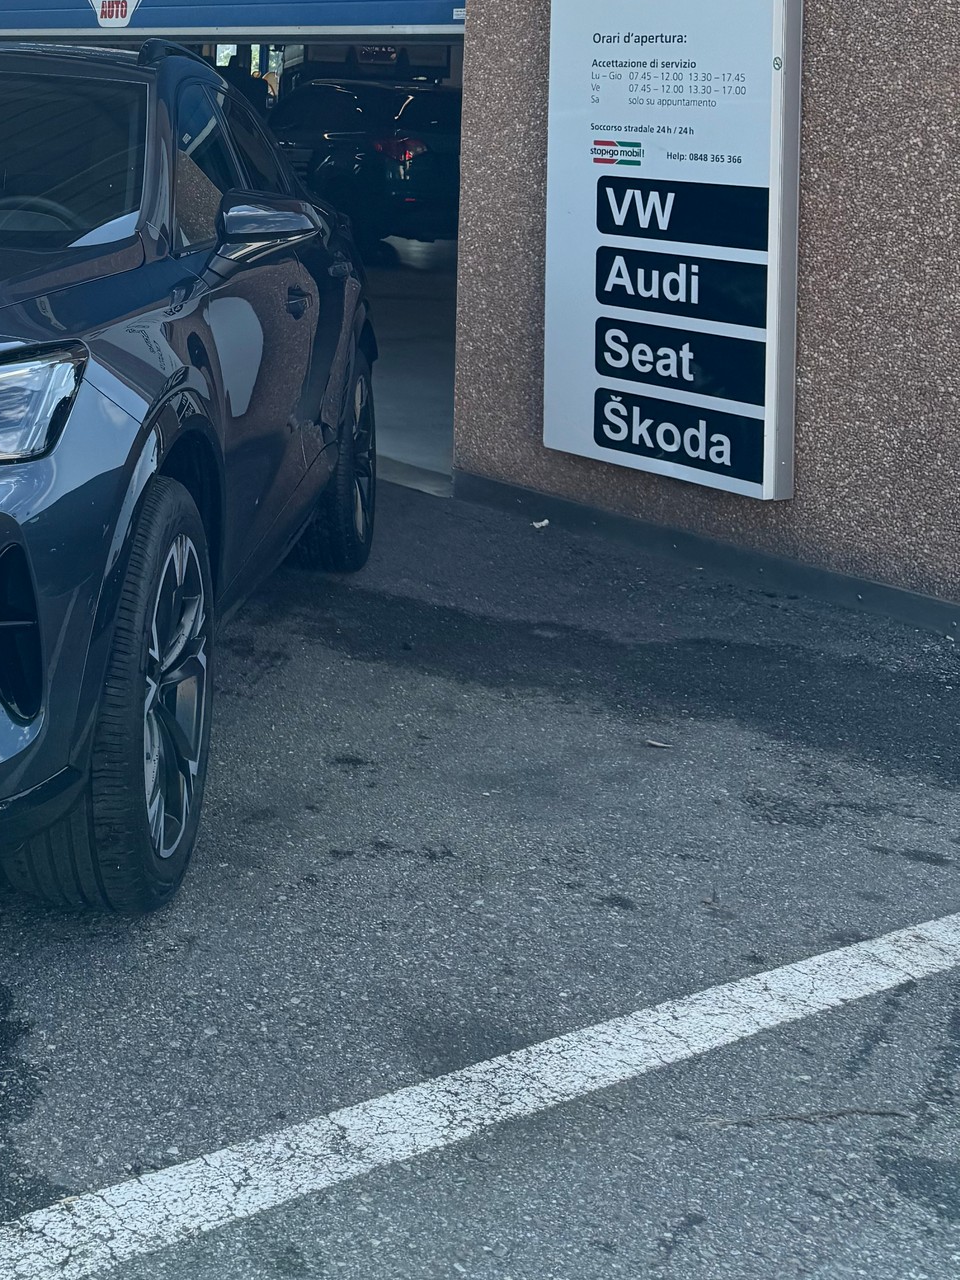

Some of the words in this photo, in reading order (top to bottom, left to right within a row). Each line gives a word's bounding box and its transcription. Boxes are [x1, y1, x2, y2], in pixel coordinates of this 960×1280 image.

[100, 0, 128, 19] AUTO
[593, 32, 620, 43] Orari
[592, 59, 647, 68] Accettazione
[650, 59, 658, 68] di
[660, 59, 697, 69] servizio
[591, 72, 600, 80] Lu
[608, 72, 622, 80] Gio
[628, 72, 652, 81] 07.45
[661, 72, 684, 82] 12.00
[689, 72, 712, 82] 13.30
[722, 73, 746, 82] 17.45
[590, 83, 600, 92] Ve
[628, 84, 652, 93] 07.45
[661, 84, 684, 94] 12.00
[688, 85, 712, 94] 13.30
[722, 86, 747, 96] 17.00
[590, 95, 600, 104] Sa
[628, 96, 644, 105] solo
[646, 98, 655, 106] su
[657, 97, 717, 108] appuntamento
[590, 122, 622, 132] Soccorso
[624, 124, 654, 134] stradale
[590, 147, 619, 158] stop+go
[666, 152, 688, 161] Help:
[689, 153, 708, 162] 0848
[710, 154, 725, 163] 365
[727, 156, 742, 164] 366
[605, 187, 676, 231] VW
[604, 255, 700, 305] Audi
[603, 329, 695, 382] Seat
[602, 395, 732, 467] Škoda
